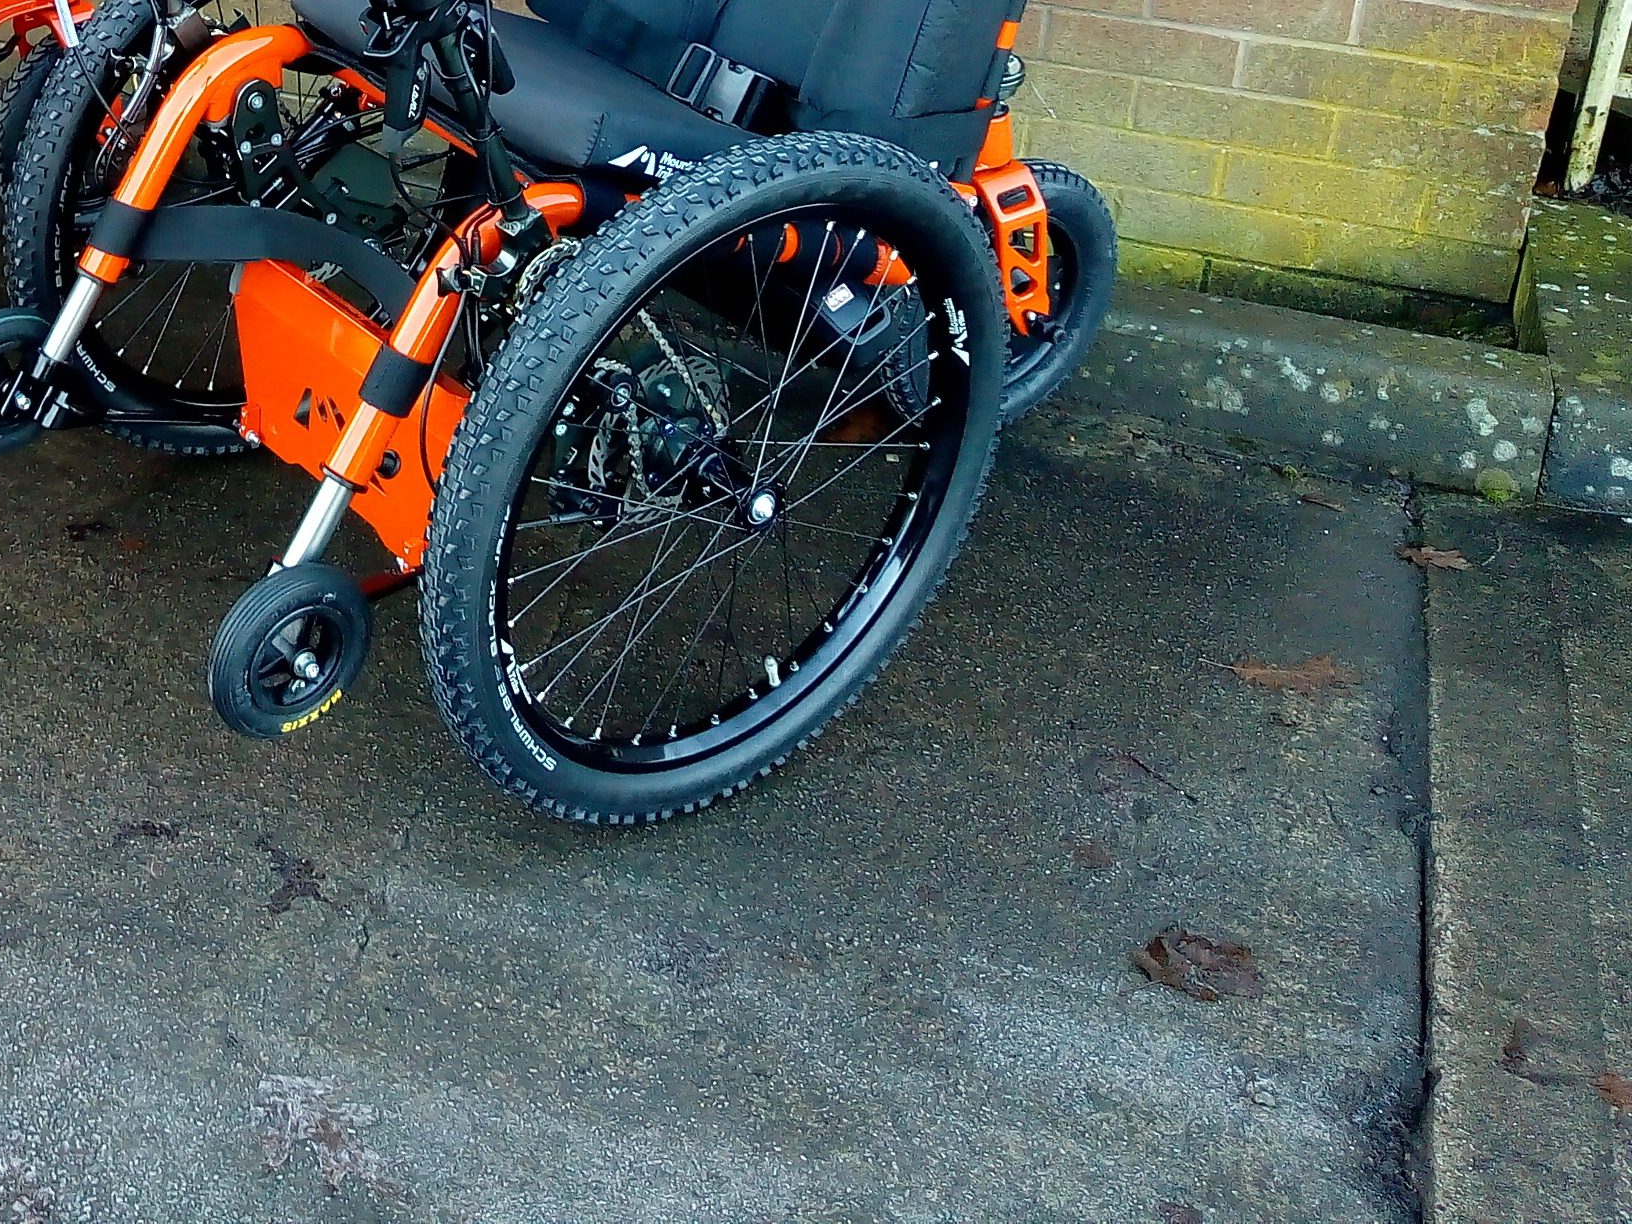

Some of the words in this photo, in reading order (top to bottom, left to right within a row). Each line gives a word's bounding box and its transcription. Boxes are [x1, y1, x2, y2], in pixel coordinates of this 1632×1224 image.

[54, 223, 63, 287] BLACK
[76, 339, 117, 393] SCHWA
[488, 579, 498, 657] BLACK
[280, 688, 343, 733] MAXXIS
[497, 681, 557, 771] SCHWALBE
